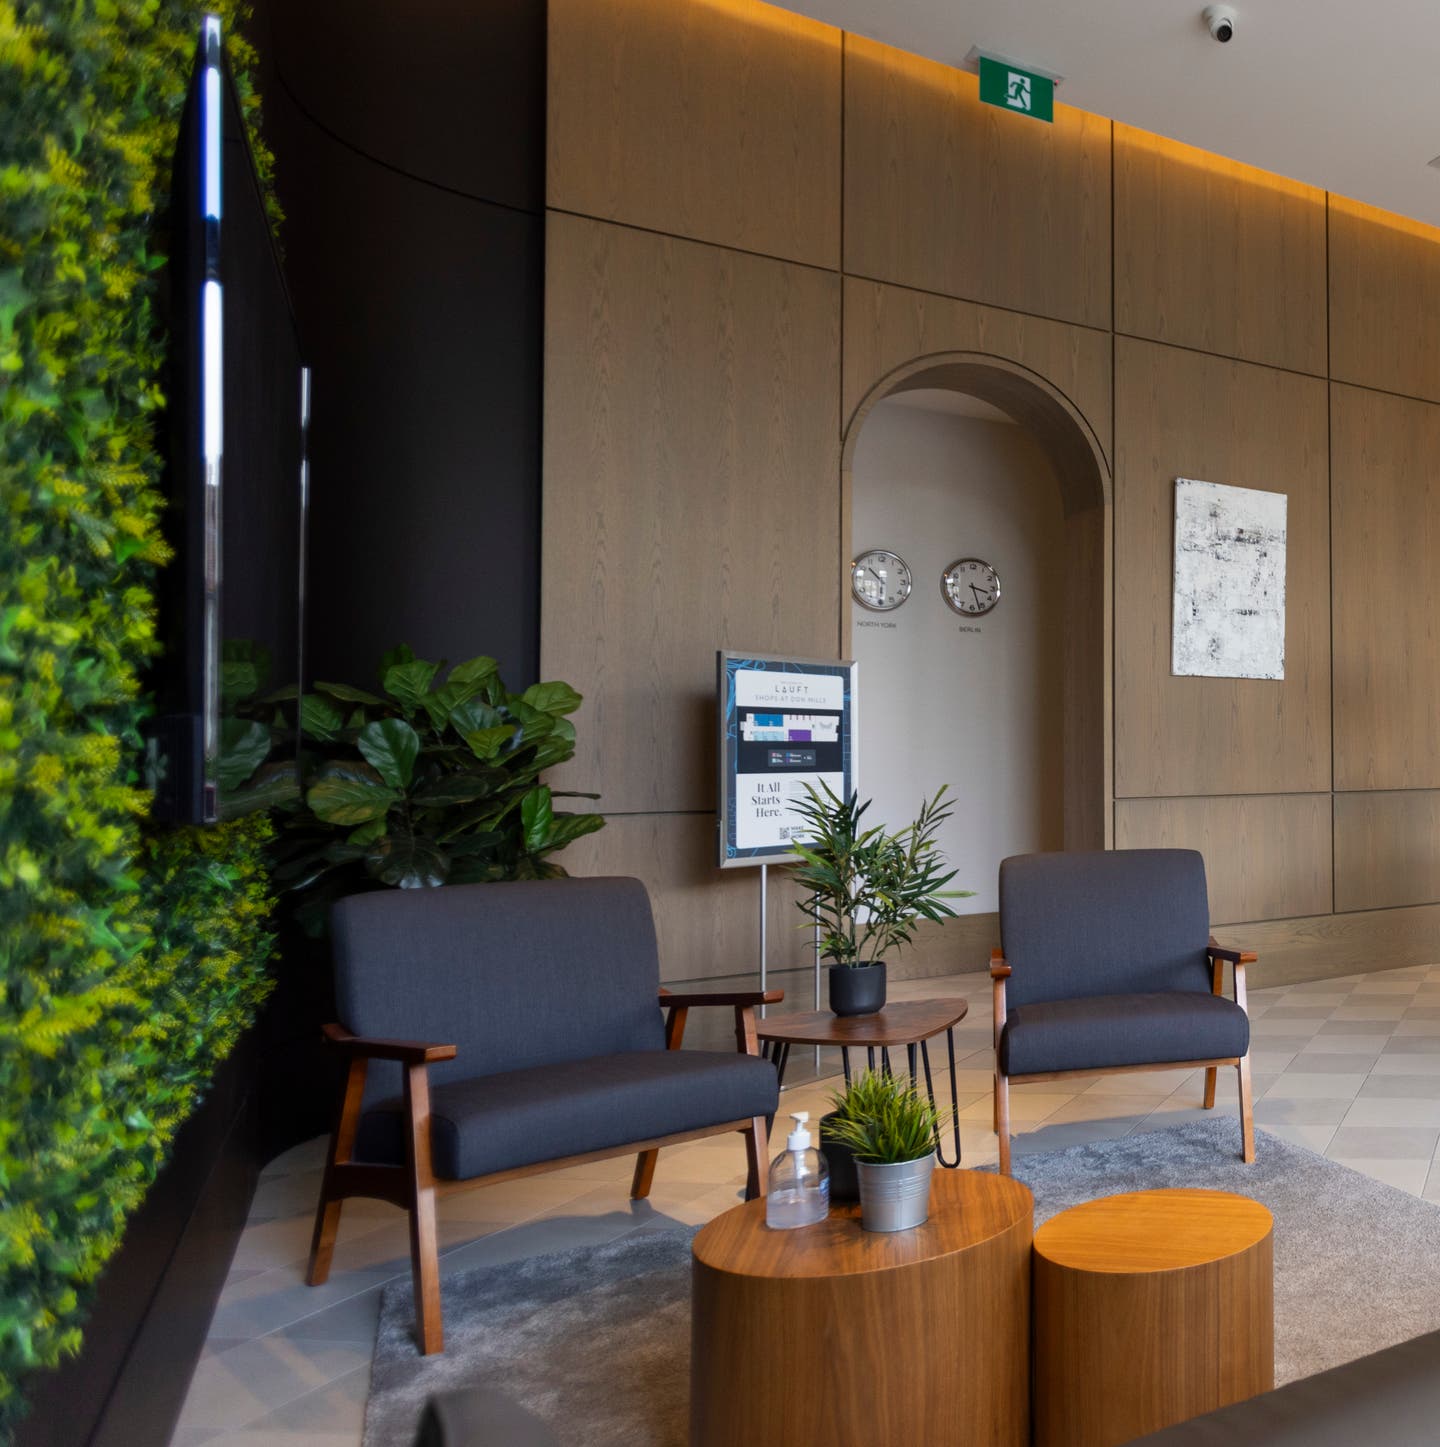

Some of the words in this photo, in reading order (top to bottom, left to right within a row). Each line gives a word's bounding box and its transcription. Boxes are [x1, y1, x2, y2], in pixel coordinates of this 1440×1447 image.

[757, 783, 765, 793] It
[766, 782, 780, 793] All
[751, 795, 781, 806] Starts
[756, 807, 782, 818] Here.
